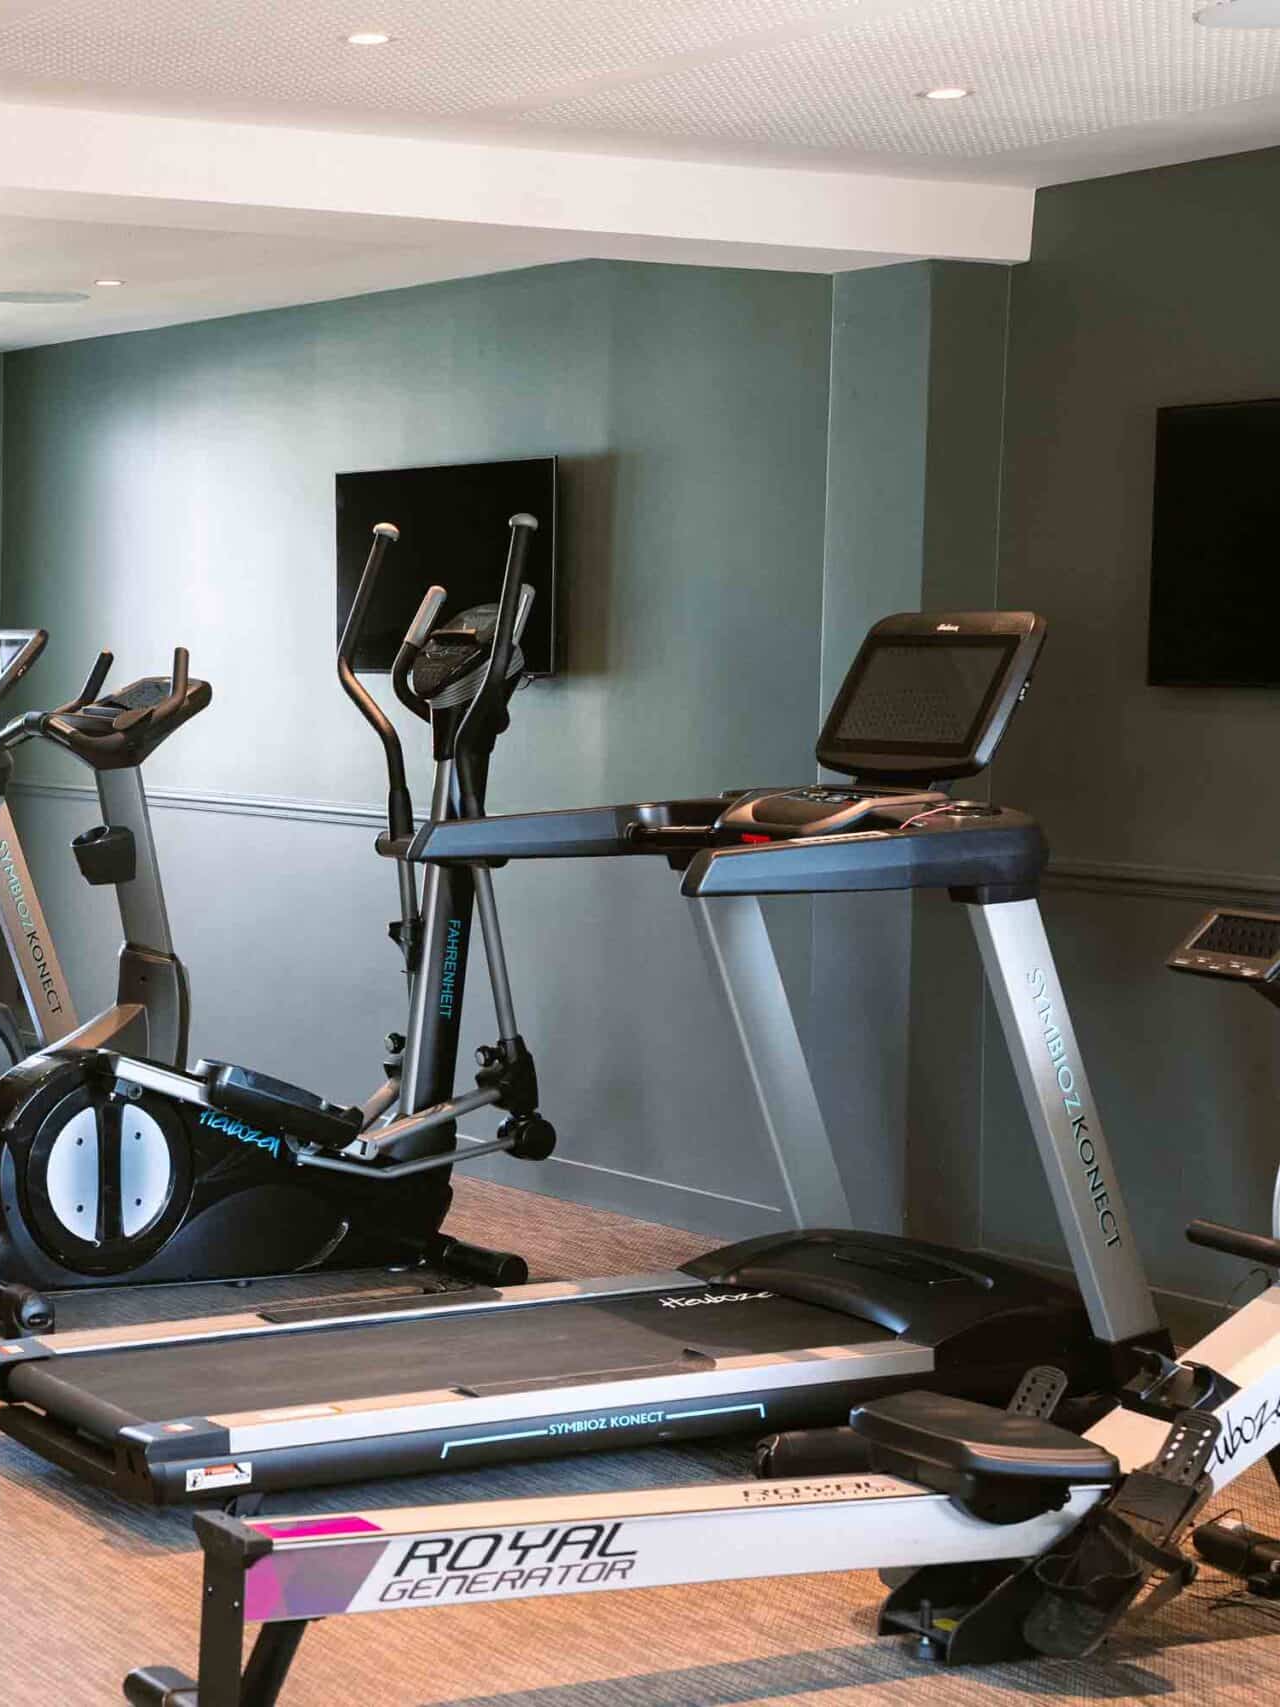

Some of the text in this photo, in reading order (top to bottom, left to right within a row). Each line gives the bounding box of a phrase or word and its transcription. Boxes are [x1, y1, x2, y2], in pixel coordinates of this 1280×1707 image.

[26, 930, 63, 1013] KONECT
[439, 919, 461, 1018] FAHRENHEIT
[1026, 967, 1121, 1247] SYMBIOZ KONECT
[658, 1291, 775, 1309] Heuboze
[548, 1411, 665, 1435] SYMBIOZ KONECT
[393, 1522, 638, 1577] ROYAL
[378, 1559, 635, 1602] GENERATOR
